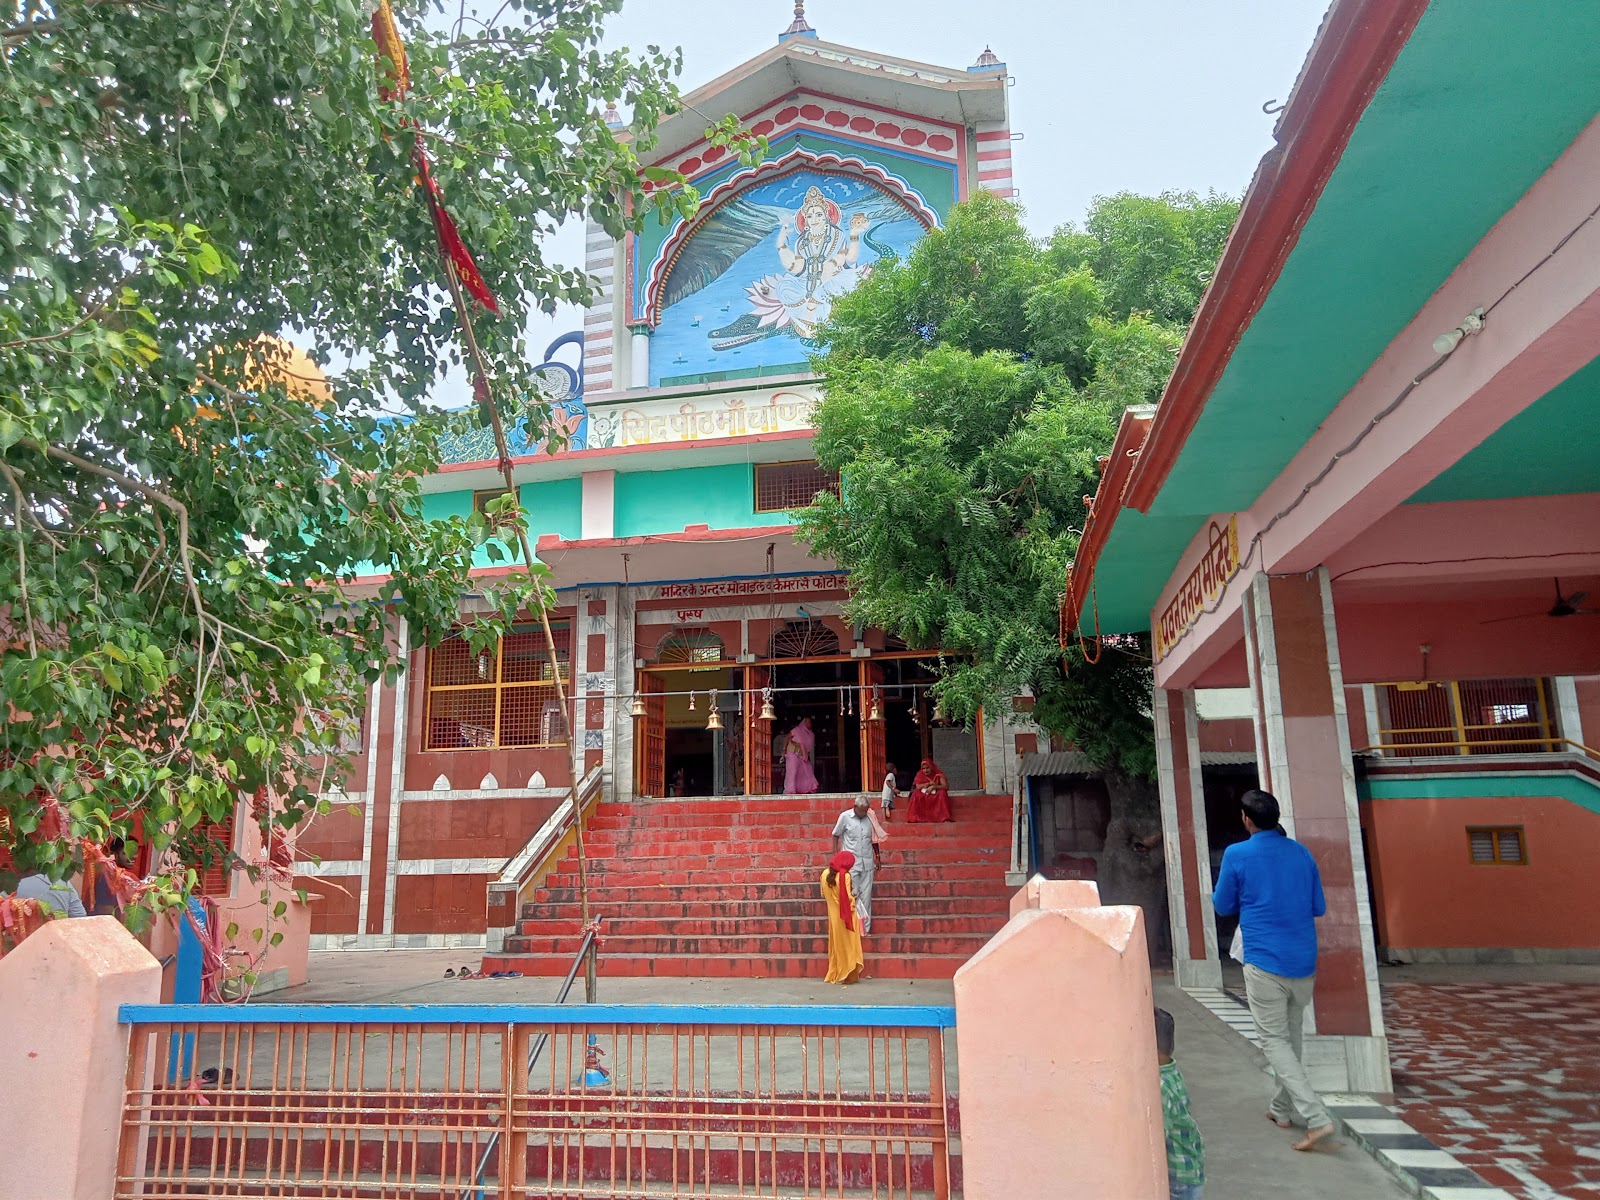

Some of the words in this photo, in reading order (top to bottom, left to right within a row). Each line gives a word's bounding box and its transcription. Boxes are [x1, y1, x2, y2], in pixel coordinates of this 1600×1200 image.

[698, 583, 727, 597] अन्दर
[727, 581, 765, 594] मोबाइल
[773, 578, 800, 591] कैमरा
[800, 576, 810, 590] से
[812, 574, 837, 589] फोटो
